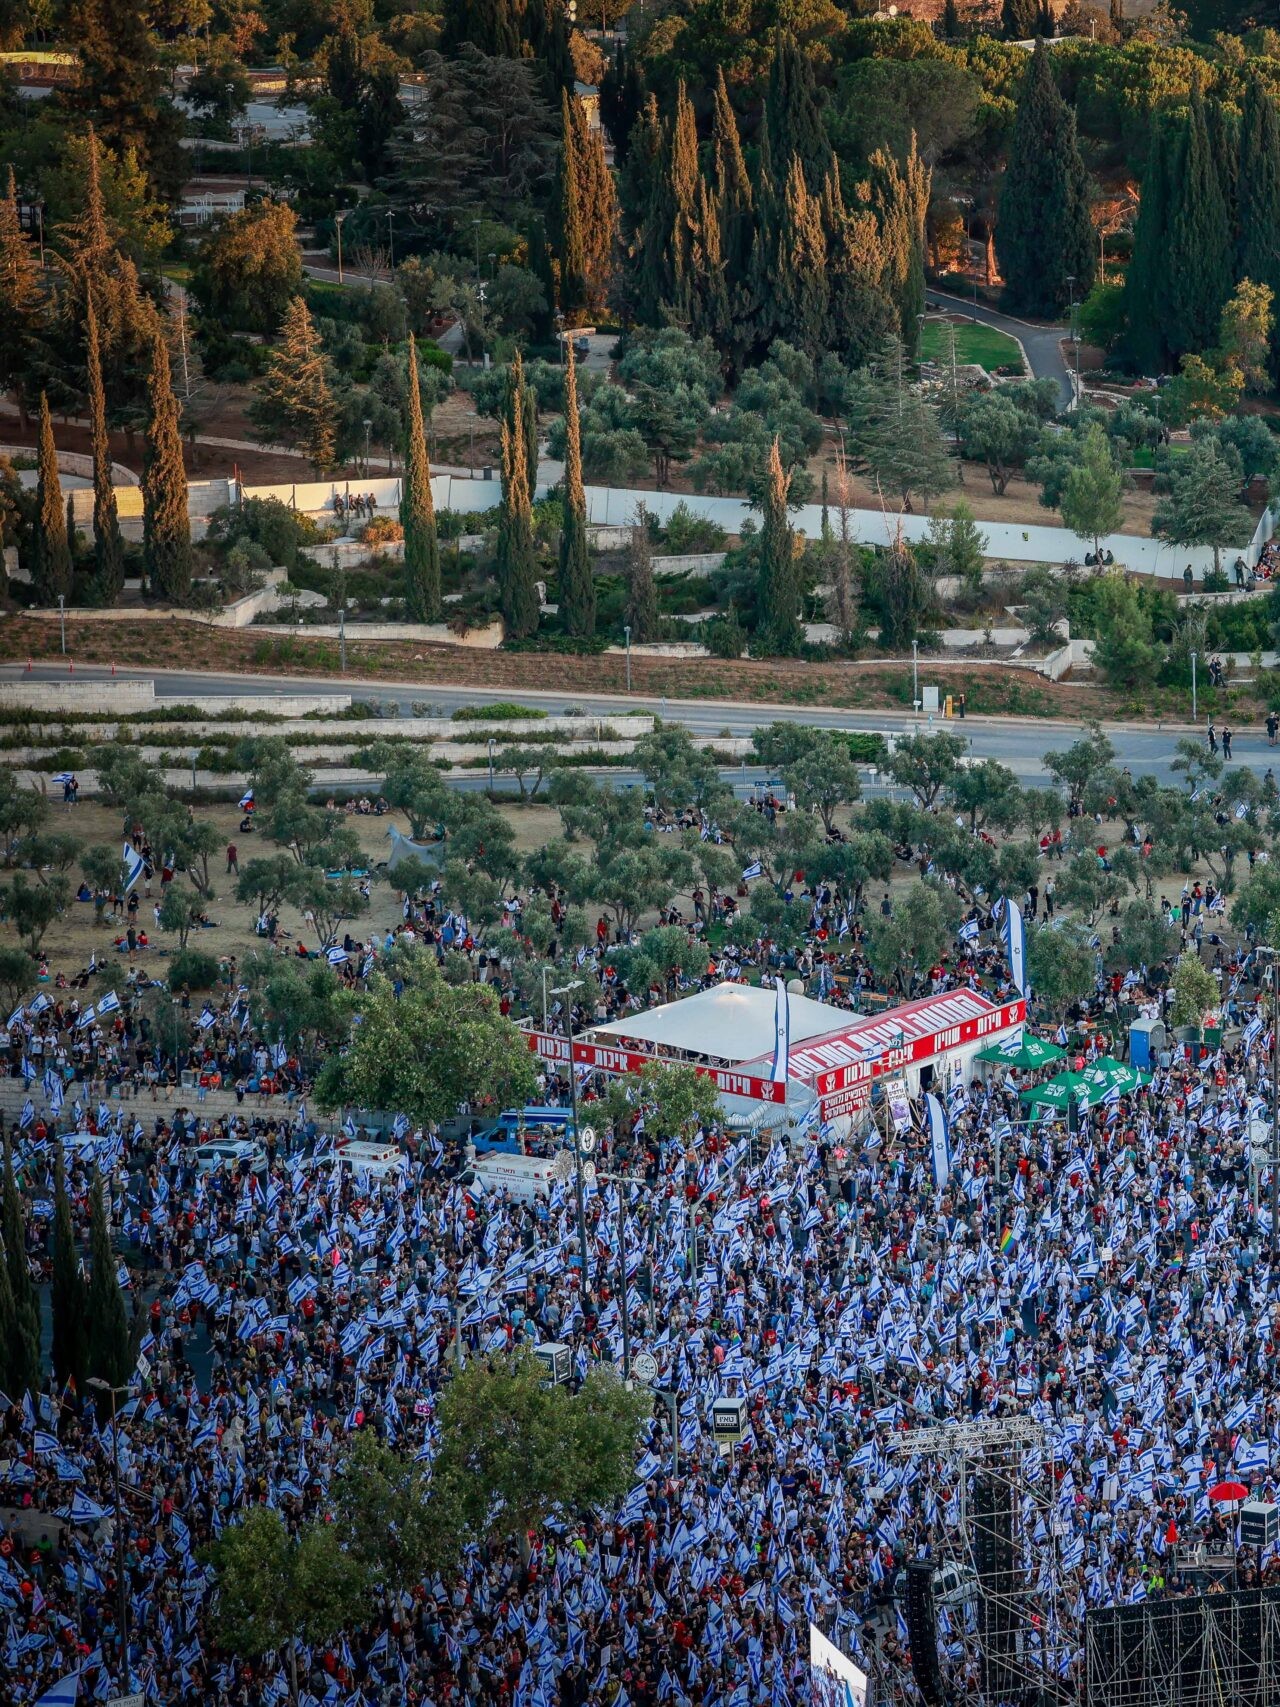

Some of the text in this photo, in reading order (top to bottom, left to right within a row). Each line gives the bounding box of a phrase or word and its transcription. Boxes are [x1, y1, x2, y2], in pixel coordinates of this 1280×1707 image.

[906, 994, 987, 1033] התנועה
[537, 1037, 751, 1095] חירות איכות שלטון
[843, 1011, 1002, 1086] חירות שוויון איכות שלטון
